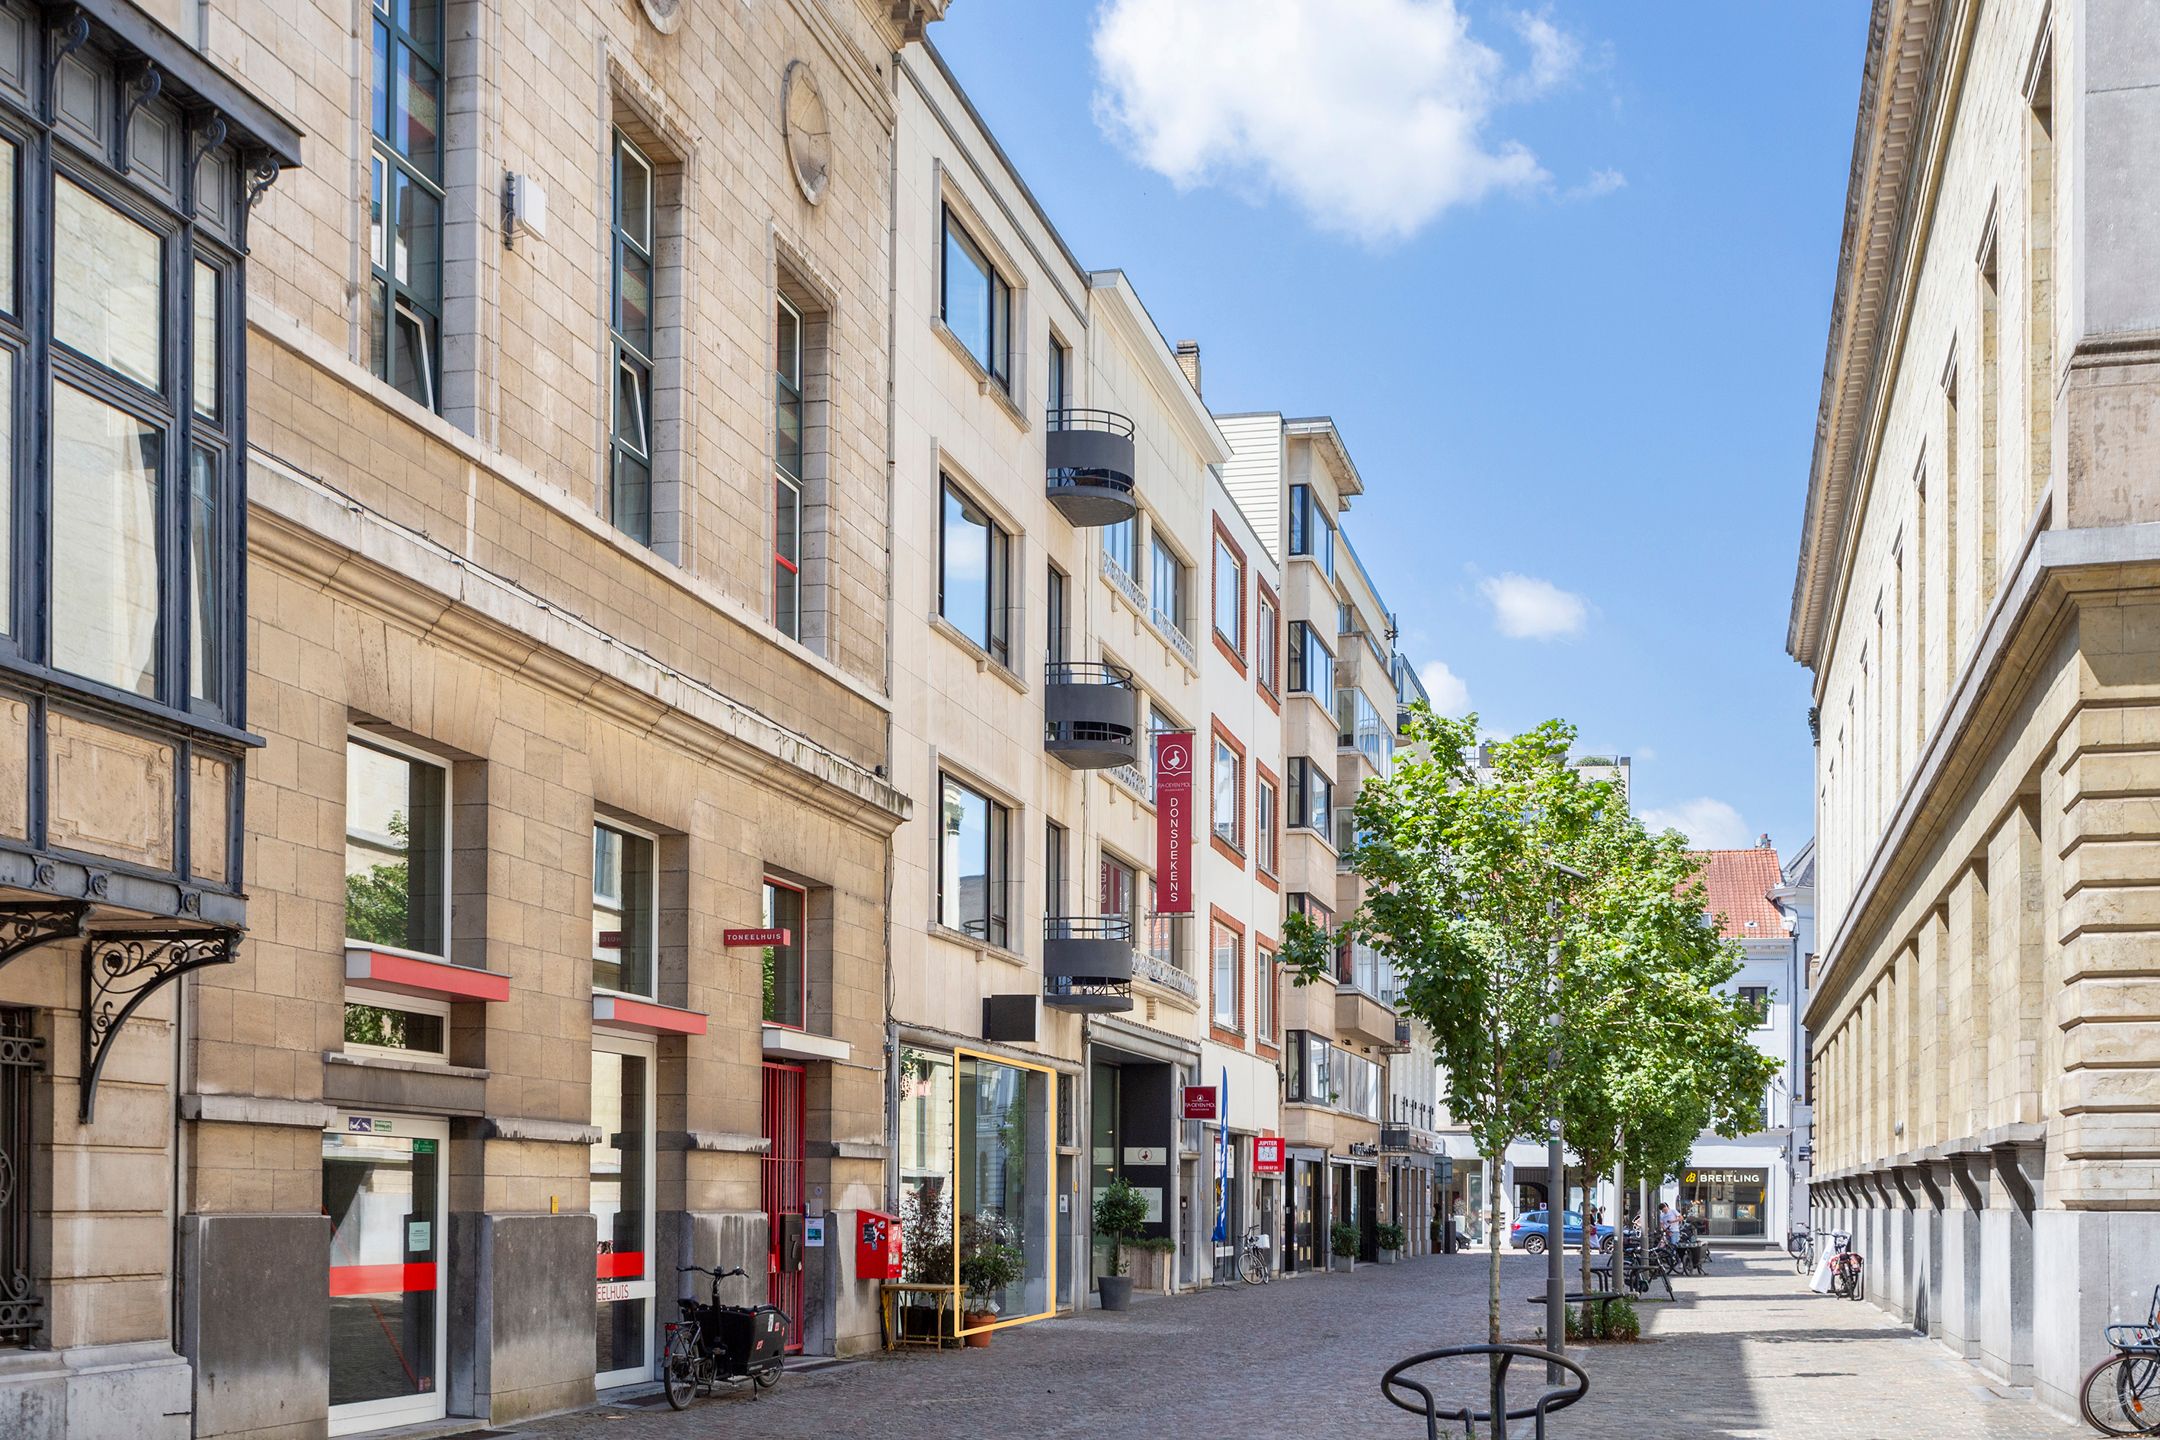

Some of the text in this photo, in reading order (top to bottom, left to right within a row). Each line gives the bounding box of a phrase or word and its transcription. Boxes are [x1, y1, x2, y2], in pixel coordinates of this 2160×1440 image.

[1170, 797, 1179, 902] DONSDEKENS
[727, 933, 782, 941] TONEELHUIS
[1700, 1174, 1760, 1183] BREITLING
